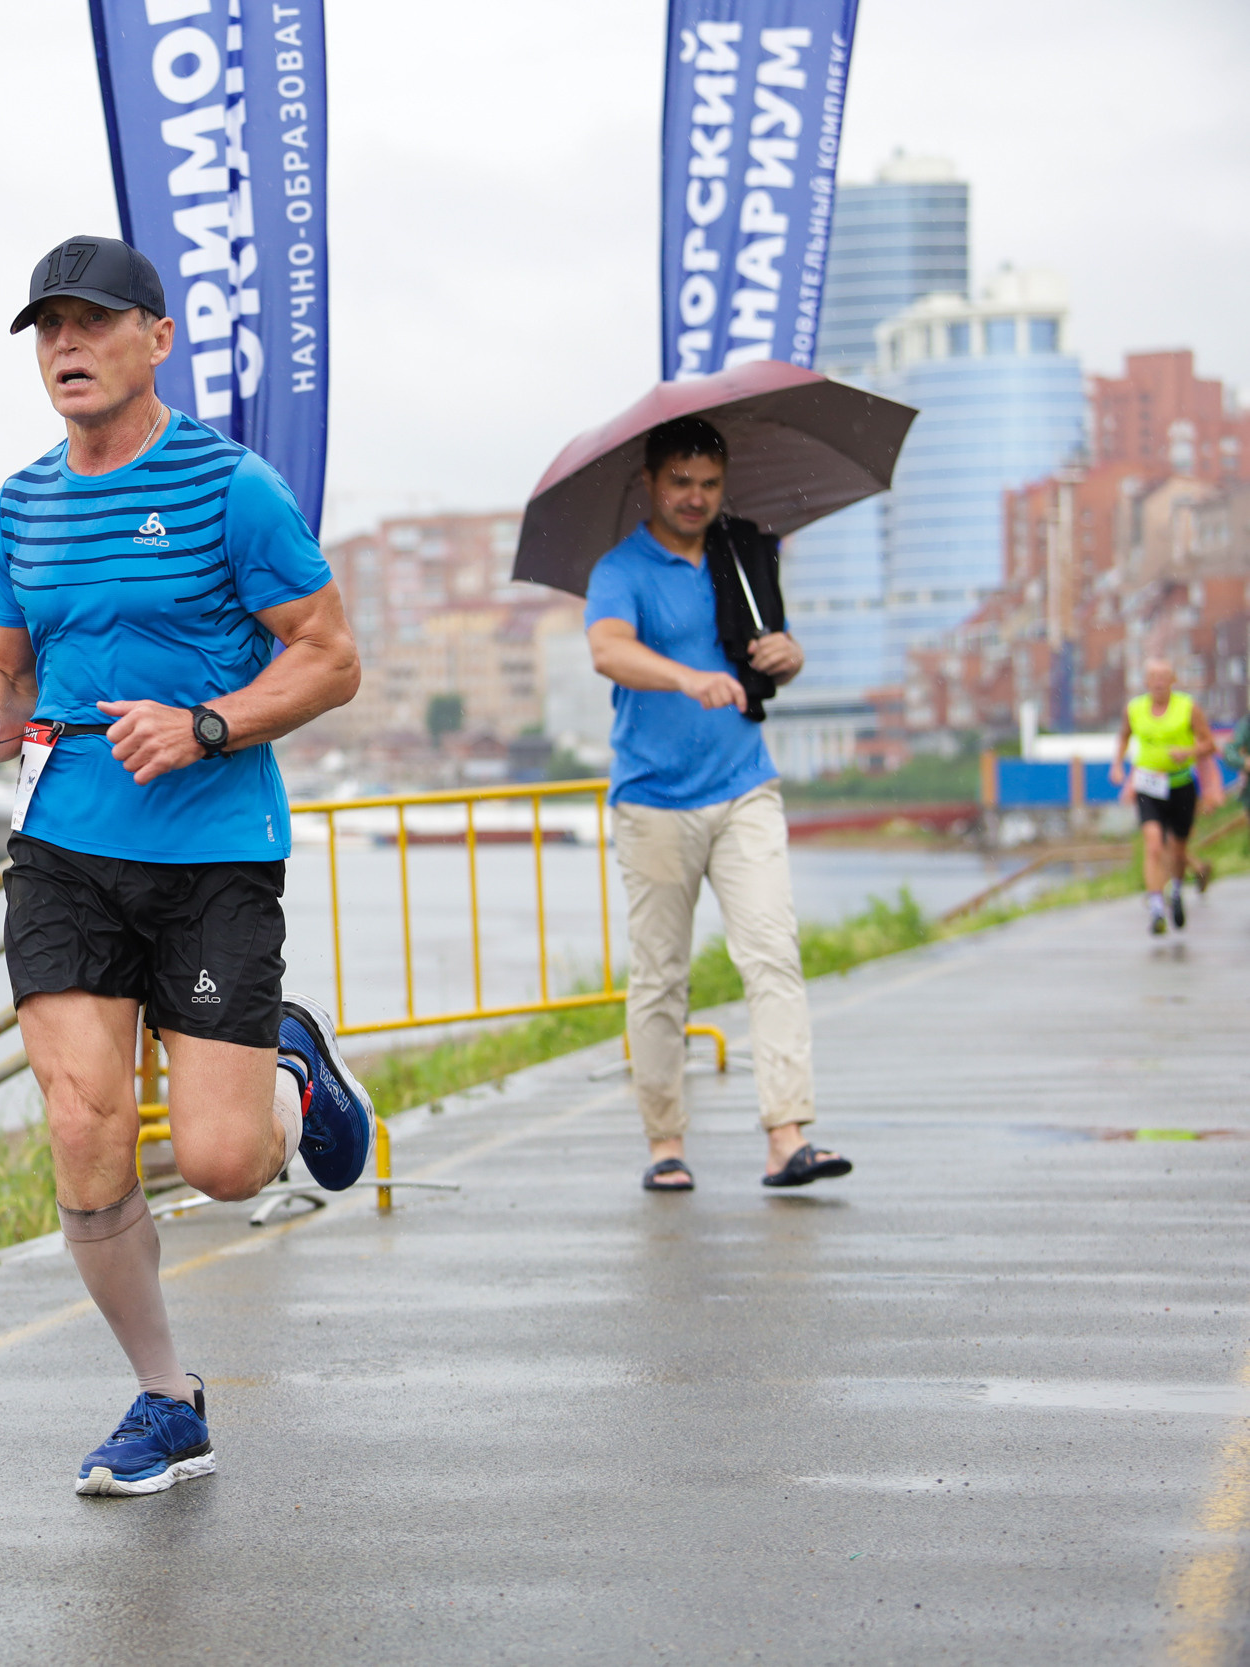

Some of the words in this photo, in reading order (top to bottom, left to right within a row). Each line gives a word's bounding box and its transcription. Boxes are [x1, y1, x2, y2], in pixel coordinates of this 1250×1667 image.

[145, 0, 233, 419] ПРИМО
[43, 243, 98, 291] 17
[133, 536, 170, 548] odlo
[191, 994, 221, 1004] odlo
